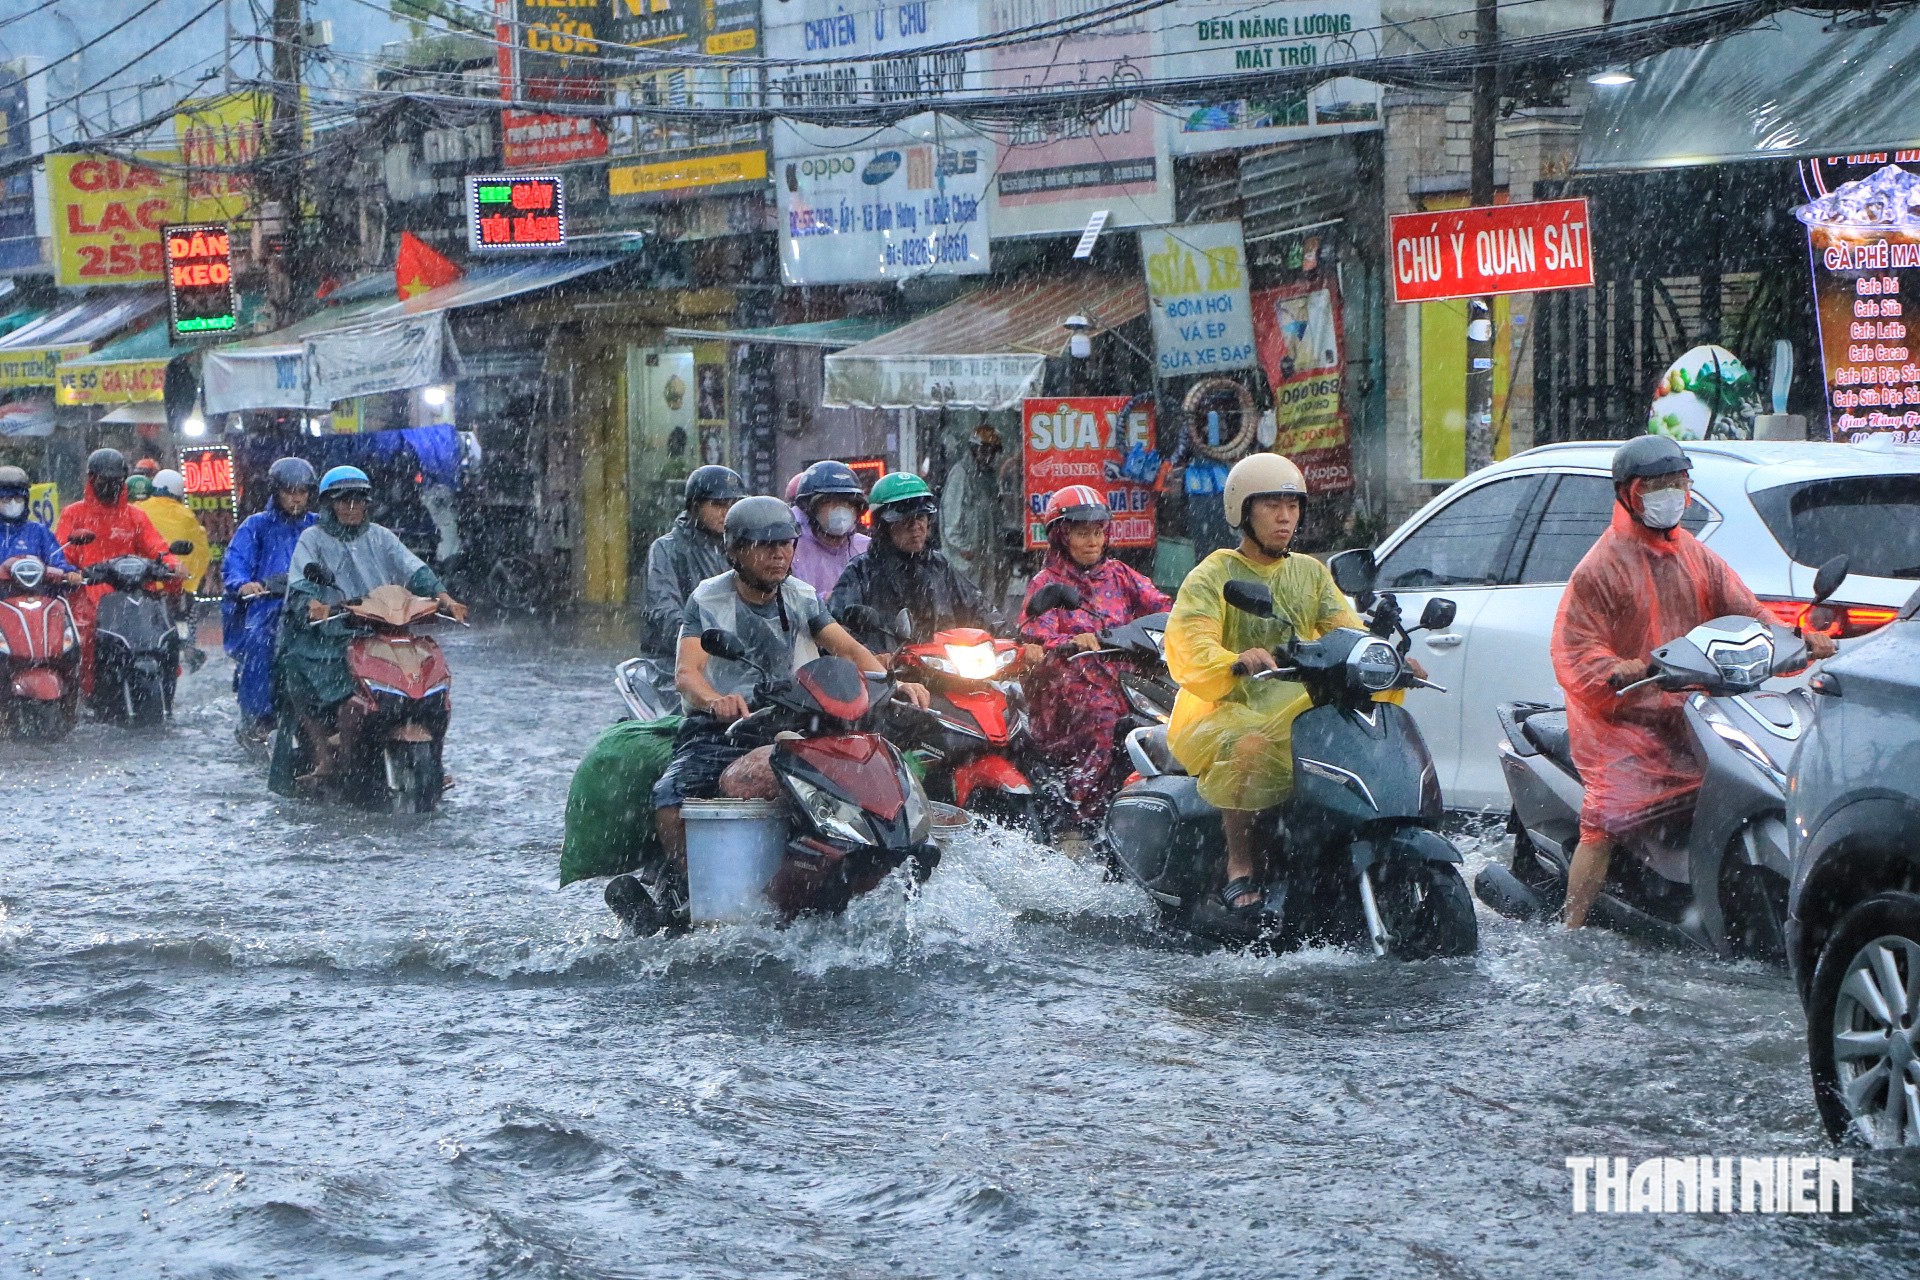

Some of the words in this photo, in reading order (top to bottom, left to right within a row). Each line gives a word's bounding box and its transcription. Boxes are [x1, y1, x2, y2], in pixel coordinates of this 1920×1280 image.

[527, 13, 597, 52] CỬA
[622, 15, 684, 40] CURTAIN
[1239, 14, 1288, 39] NĂNG
[1236, 45, 1272, 72] MẶT
[1278, 42, 1317, 67] TRỜI
[170, 232, 229, 258] DÁN
[1397, 222, 1442, 285] CHÚ
[1450, 220, 1465, 279] Ý
[1476, 226, 1536, 277] QUAN
[1544, 210, 1584, 271] SÁT
[1824, 240, 1853, 271] CÀ
[1855, 239, 1888, 269] PHÊ
[77, 241, 165, 276] 258
[172, 263, 230, 287] KEO
[1856, 278, 1882, 295] Cafe
[1883, 276, 1899, 293] Đá
[1854, 300, 1879, 317] Cafe
[1880, 299, 1902, 316] Sữa
[1180, 321, 1203, 342] VÁ
[1206, 320, 1226, 339] ÉP
[1851, 322, 1875, 339] Cafe
[1877, 322, 1906, 338] Latte
[1196, 348, 1216, 365] XE
[1849, 345, 1874, 362] Cafe
[1875, 344, 1908, 361] Cacao
[1836, 368, 1860, 385] Cafe
[1861, 367, 1877, 384] Đá
[1879, 366, 1900, 386] Đặc
[1833, 390, 1858, 408] Cafe
[1859, 389, 1880, 405] Sữa
[1882, 388, 1903, 408] Đặc
[1031, 404, 1100, 451] SỬA
[1837, 414, 1867, 431] Giao
[185, 452, 233, 492] DÁN
[1053, 464, 1099, 476] HONDA
[1107, 487, 1128, 513] VÁ
